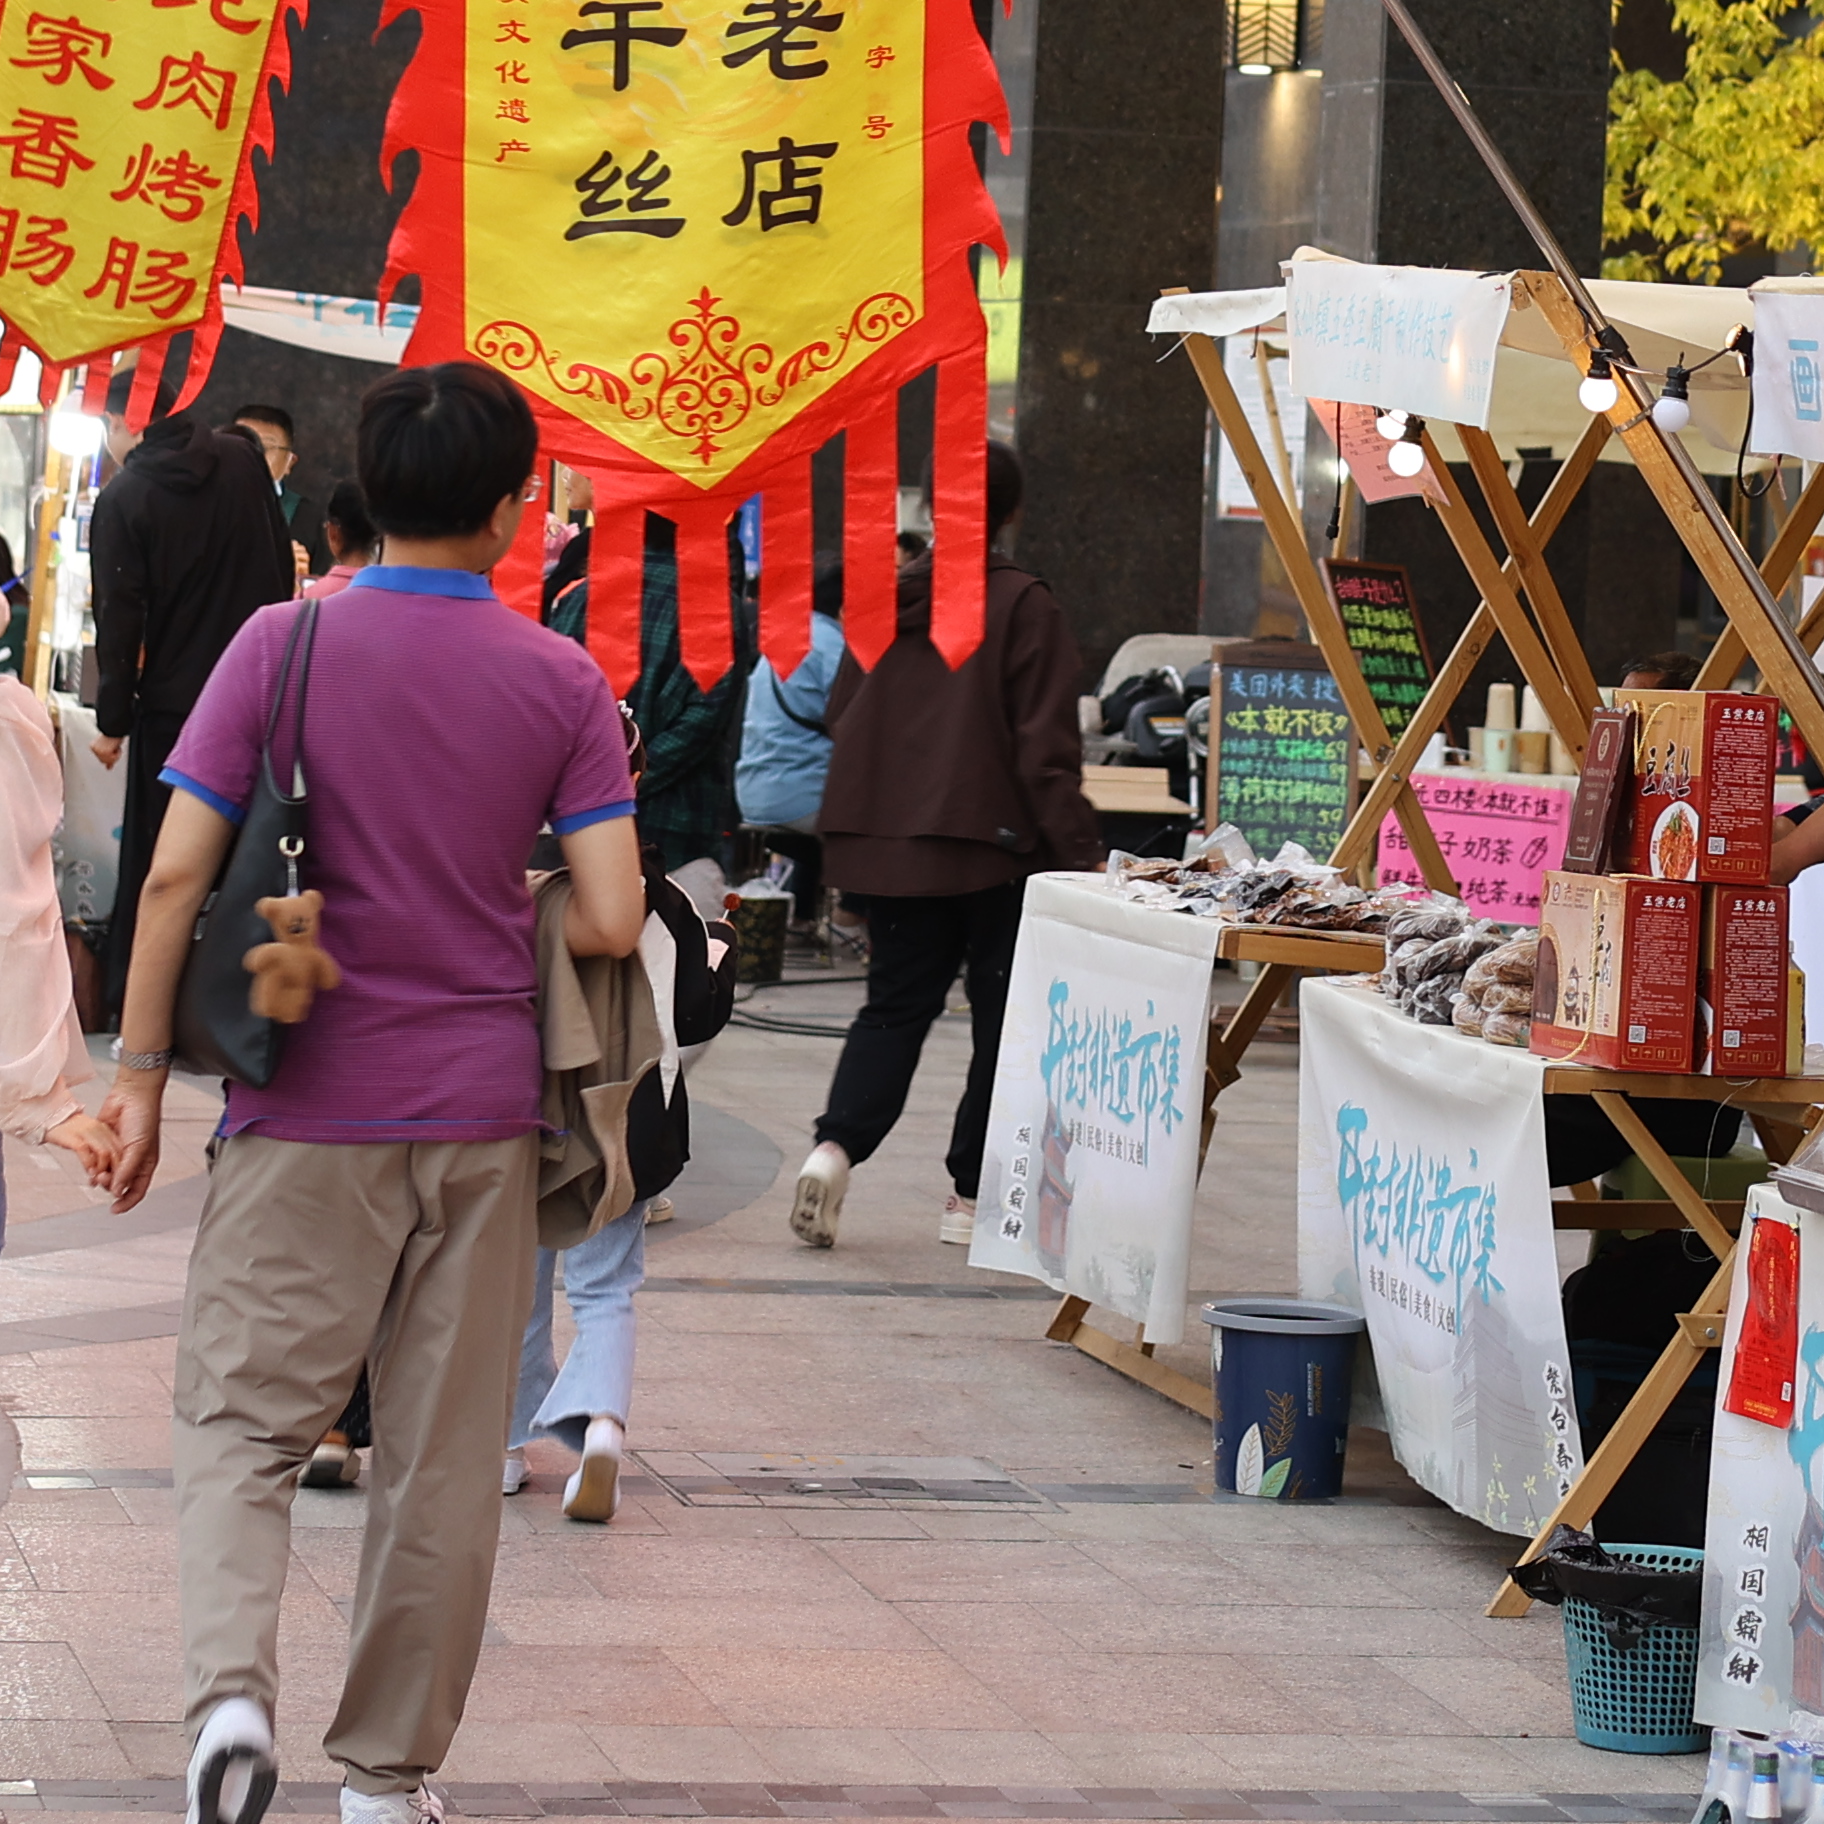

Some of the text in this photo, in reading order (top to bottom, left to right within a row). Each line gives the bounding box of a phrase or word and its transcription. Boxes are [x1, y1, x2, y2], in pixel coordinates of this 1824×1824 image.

[1384, 827, 1514, 866] 甜子奶茶
[1040, 976, 1184, 1168] 开封非遗市集
[1337, 1100, 1505, 1336] 开封非遗市集
